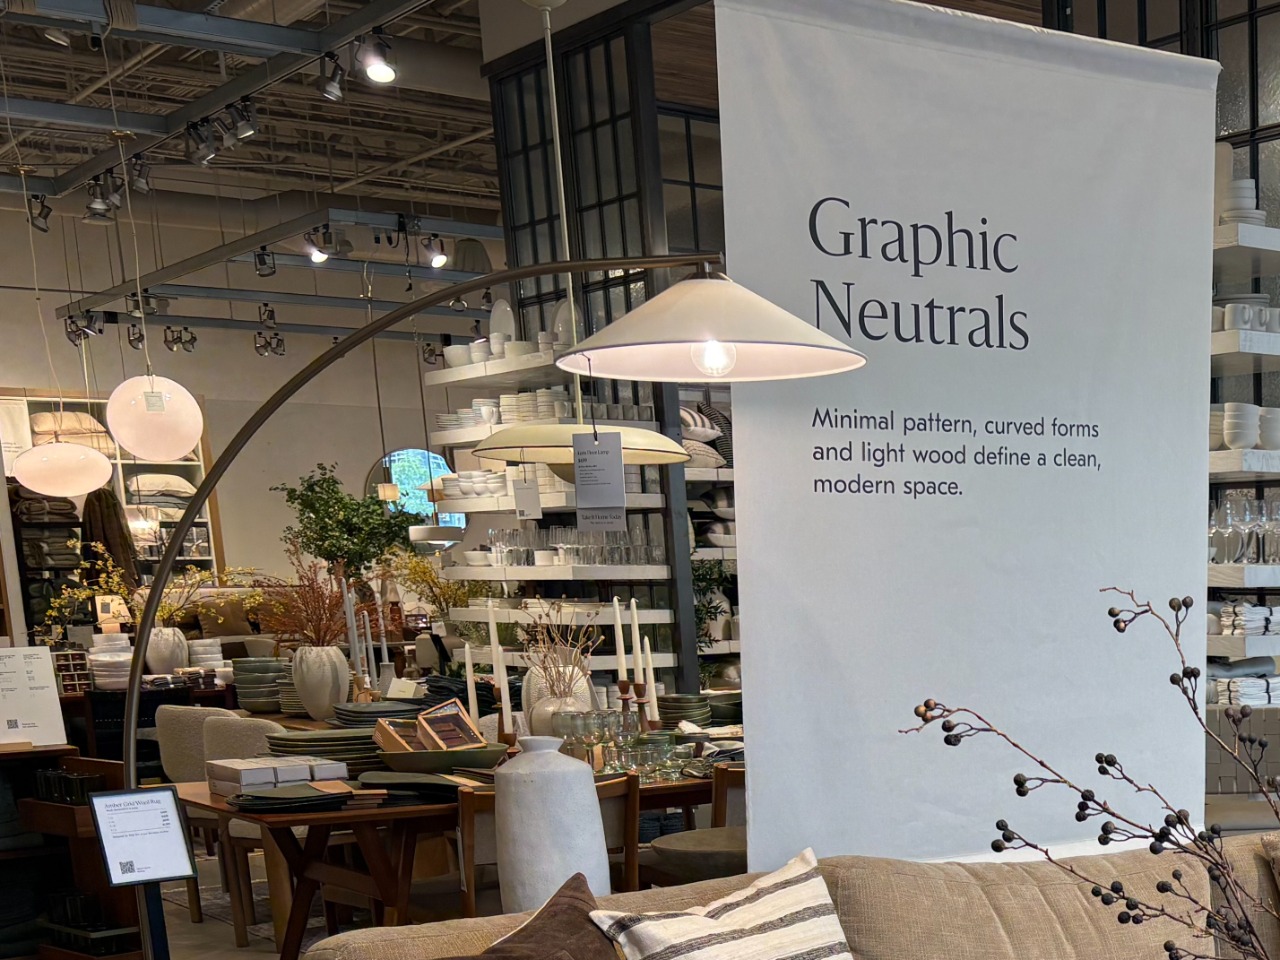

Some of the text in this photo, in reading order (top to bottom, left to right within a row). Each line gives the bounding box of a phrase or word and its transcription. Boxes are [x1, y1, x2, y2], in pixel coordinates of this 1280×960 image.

[809, 197, 1019, 277] Graphic
[810, 279, 1029, 350] Neutrals
[812, 408, 1099, 437] Minimal pattern, curved forms
[812, 441, 1101, 471] and light wood define a clean,
[813, 474, 962, 499] modern space.
